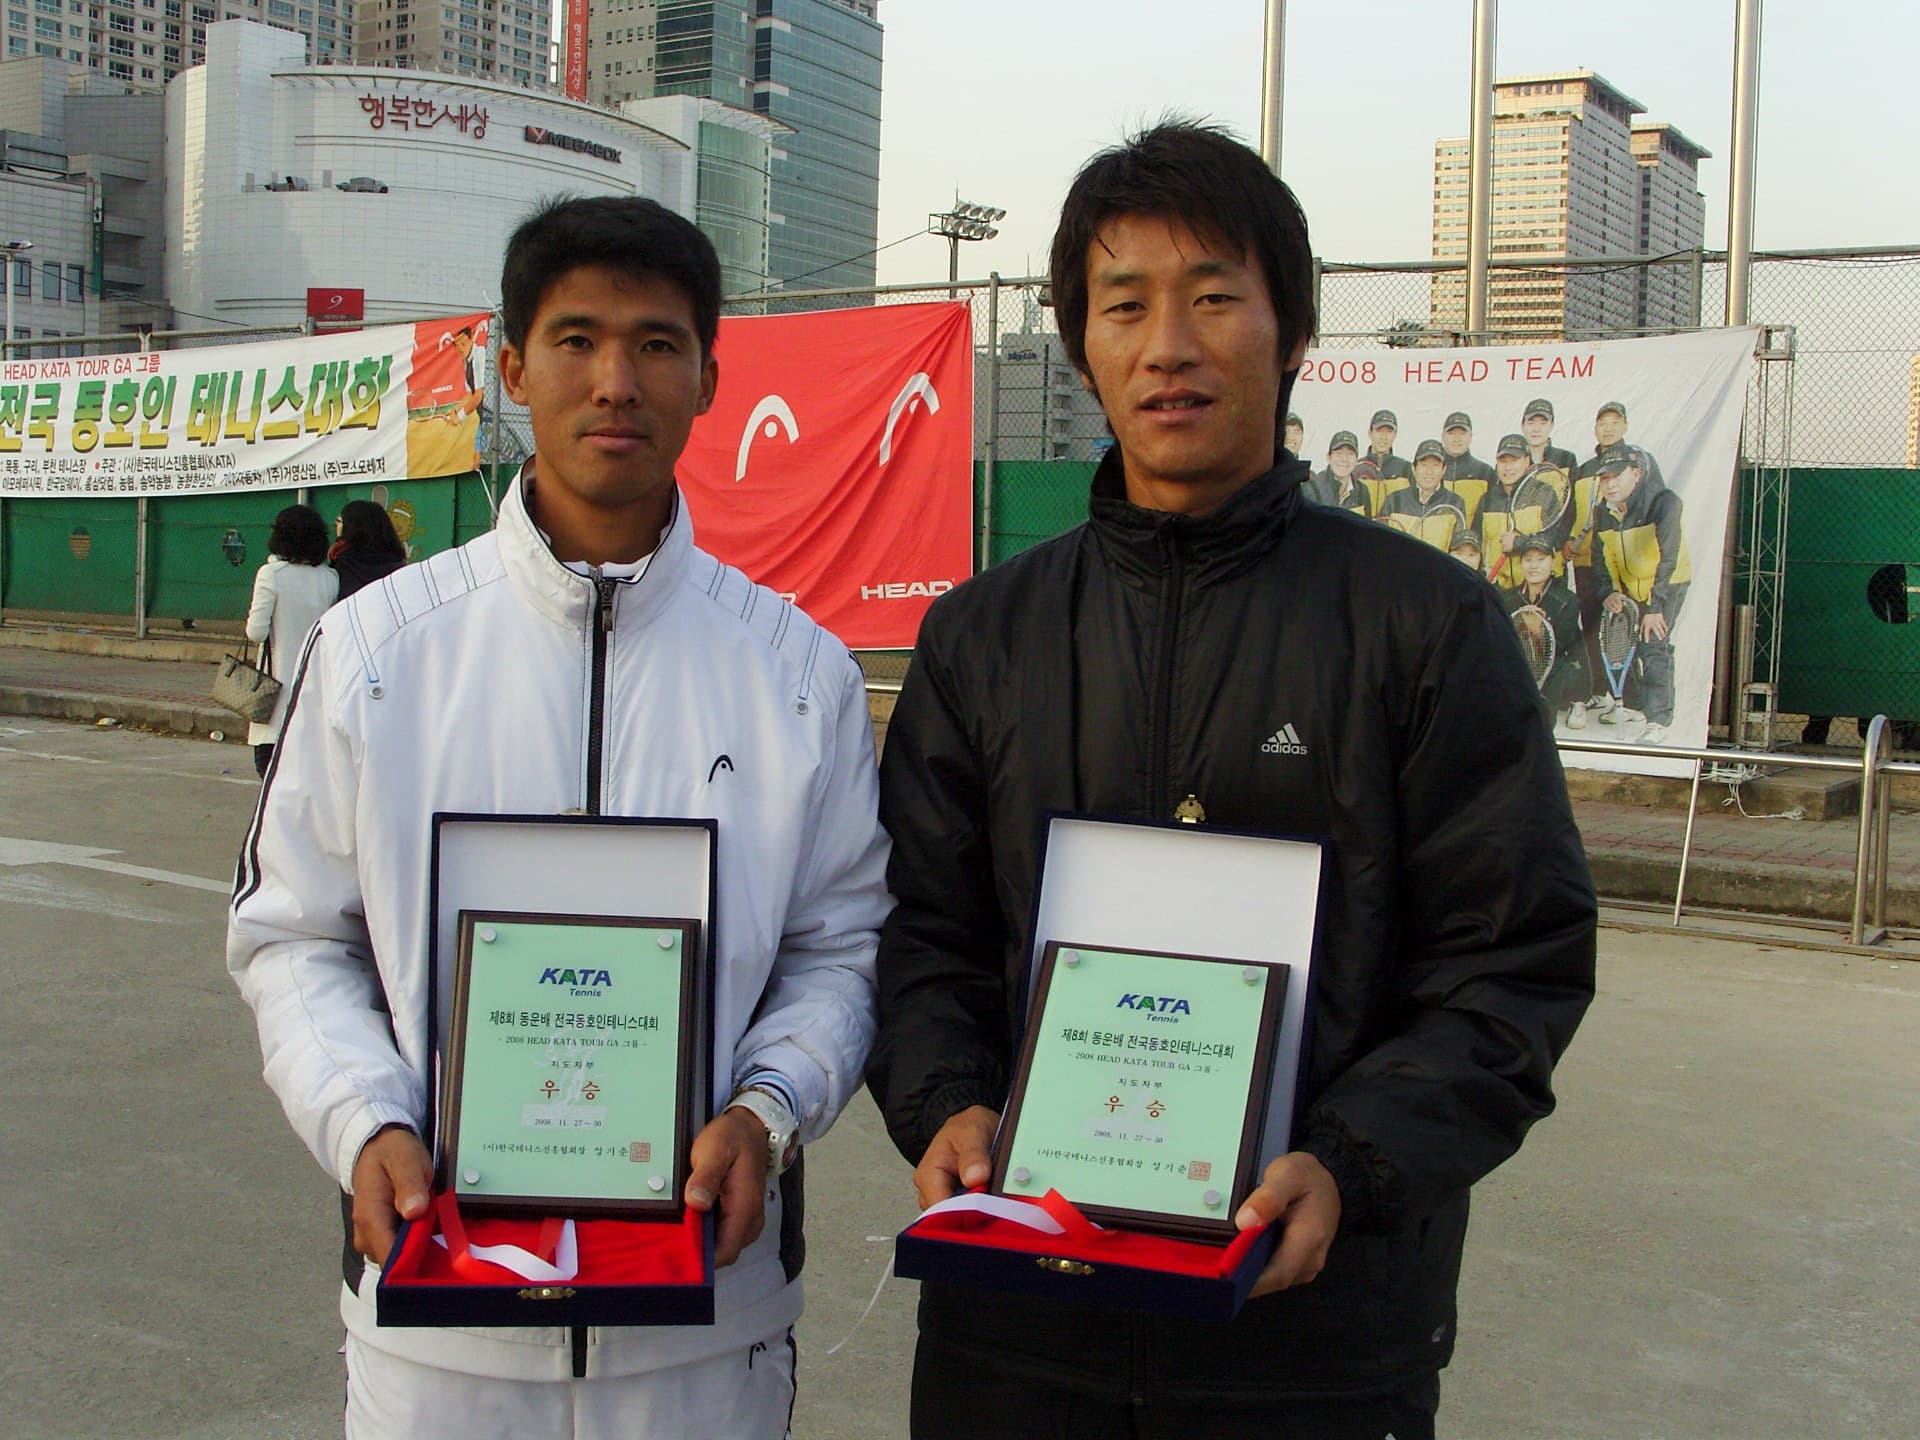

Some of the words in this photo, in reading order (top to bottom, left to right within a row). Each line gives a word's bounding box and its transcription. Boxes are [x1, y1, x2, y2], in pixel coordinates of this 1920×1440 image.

[358, 93, 490, 139] 행복한세상
[548, 132, 622, 164] MEGABOX
[4, 364, 37, 380] HEAD
[41, 361, 71, 378] KATA
[76, 359, 110, 376] TOUR
[113, 358, 132, 374] GA
[136, 354, 160, 373] 그룹
[1300, 360, 1376, 383] 2008
[1404, 360, 1489, 383] HEAD
[1506, 355, 1595, 381] TEAM
[0, 380, 62, 453] 전국
[71, 376, 177, 453] 동호인
[186, 355, 394, 447] 테니스대회
[42, 459, 57, 474] 부천
[861, 581, 954, 600] HEAD
[1261, 742, 1308, 755] adidas
[539, 968, 612, 986] KATA
[569, 988, 601, 997] Tennis
[1116, 993, 1191, 1015] KATA
[489, 1010, 515, 1026] 제8회
[519, 1011, 550, 1027] 동운배
[555, 1012, 659, 1031] 전국동호인테니스대회
[1145, 1013, 1179, 1024] Tennis
[506, 1035, 525, 1044] 2008
[527, 1036, 550, 1045] HEAD
[553, 1037, 577, 1046] KATA
[606, 1039, 619, 1047] GA
[1061, 1028, 1088, 1043] 제8회
[1091, 1031, 1124, 1048] 동운배
[1127, 1035, 1235, 1060] 전국동호인테니스대회
[1075, 1052, 1094, 1062] 2008
[1096, 1054, 1121, 1064] HEAD
[1123, 1056, 1148, 1067] KATA
[1151, 1059, 1175, 1070] TOUR
[1178, 1062, 1191, 1072] GA
